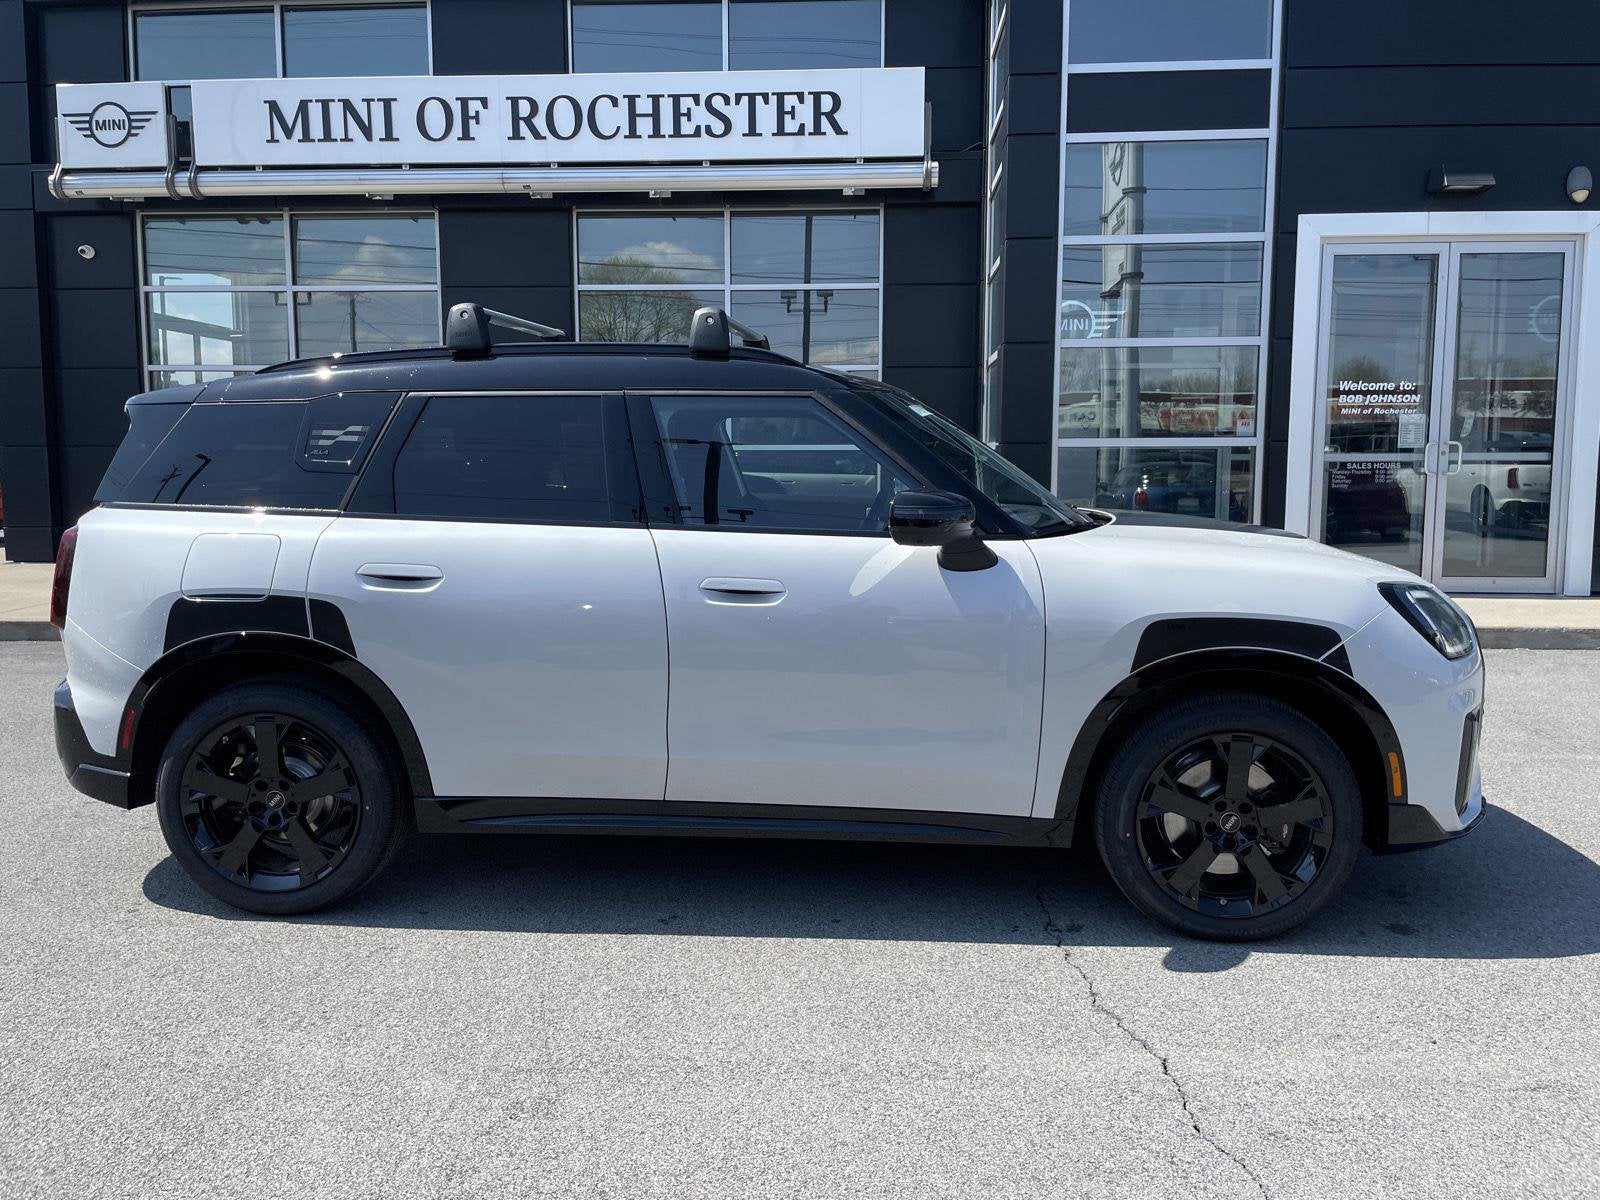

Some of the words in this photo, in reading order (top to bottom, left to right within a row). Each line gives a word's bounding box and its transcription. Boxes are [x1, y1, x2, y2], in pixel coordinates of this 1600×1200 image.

[263, 97, 400, 144] MINI
[415, 96, 489, 142] OF
[505, 90, 849, 141] ROCHESTER
[95, 118, 127, 132] MINI
[1339, 380, 1396, 391] Welcome
[1399, 380, 1417, 391] to:
[1338, 394, 1363, 404] BOB
[1364, 394, 1421, 405] JOHNSON
[1340, 407, 1361, 415] MINI
[1362, 407, 1373, 415] of
[1373, 407, 1417, 415] Rochester
